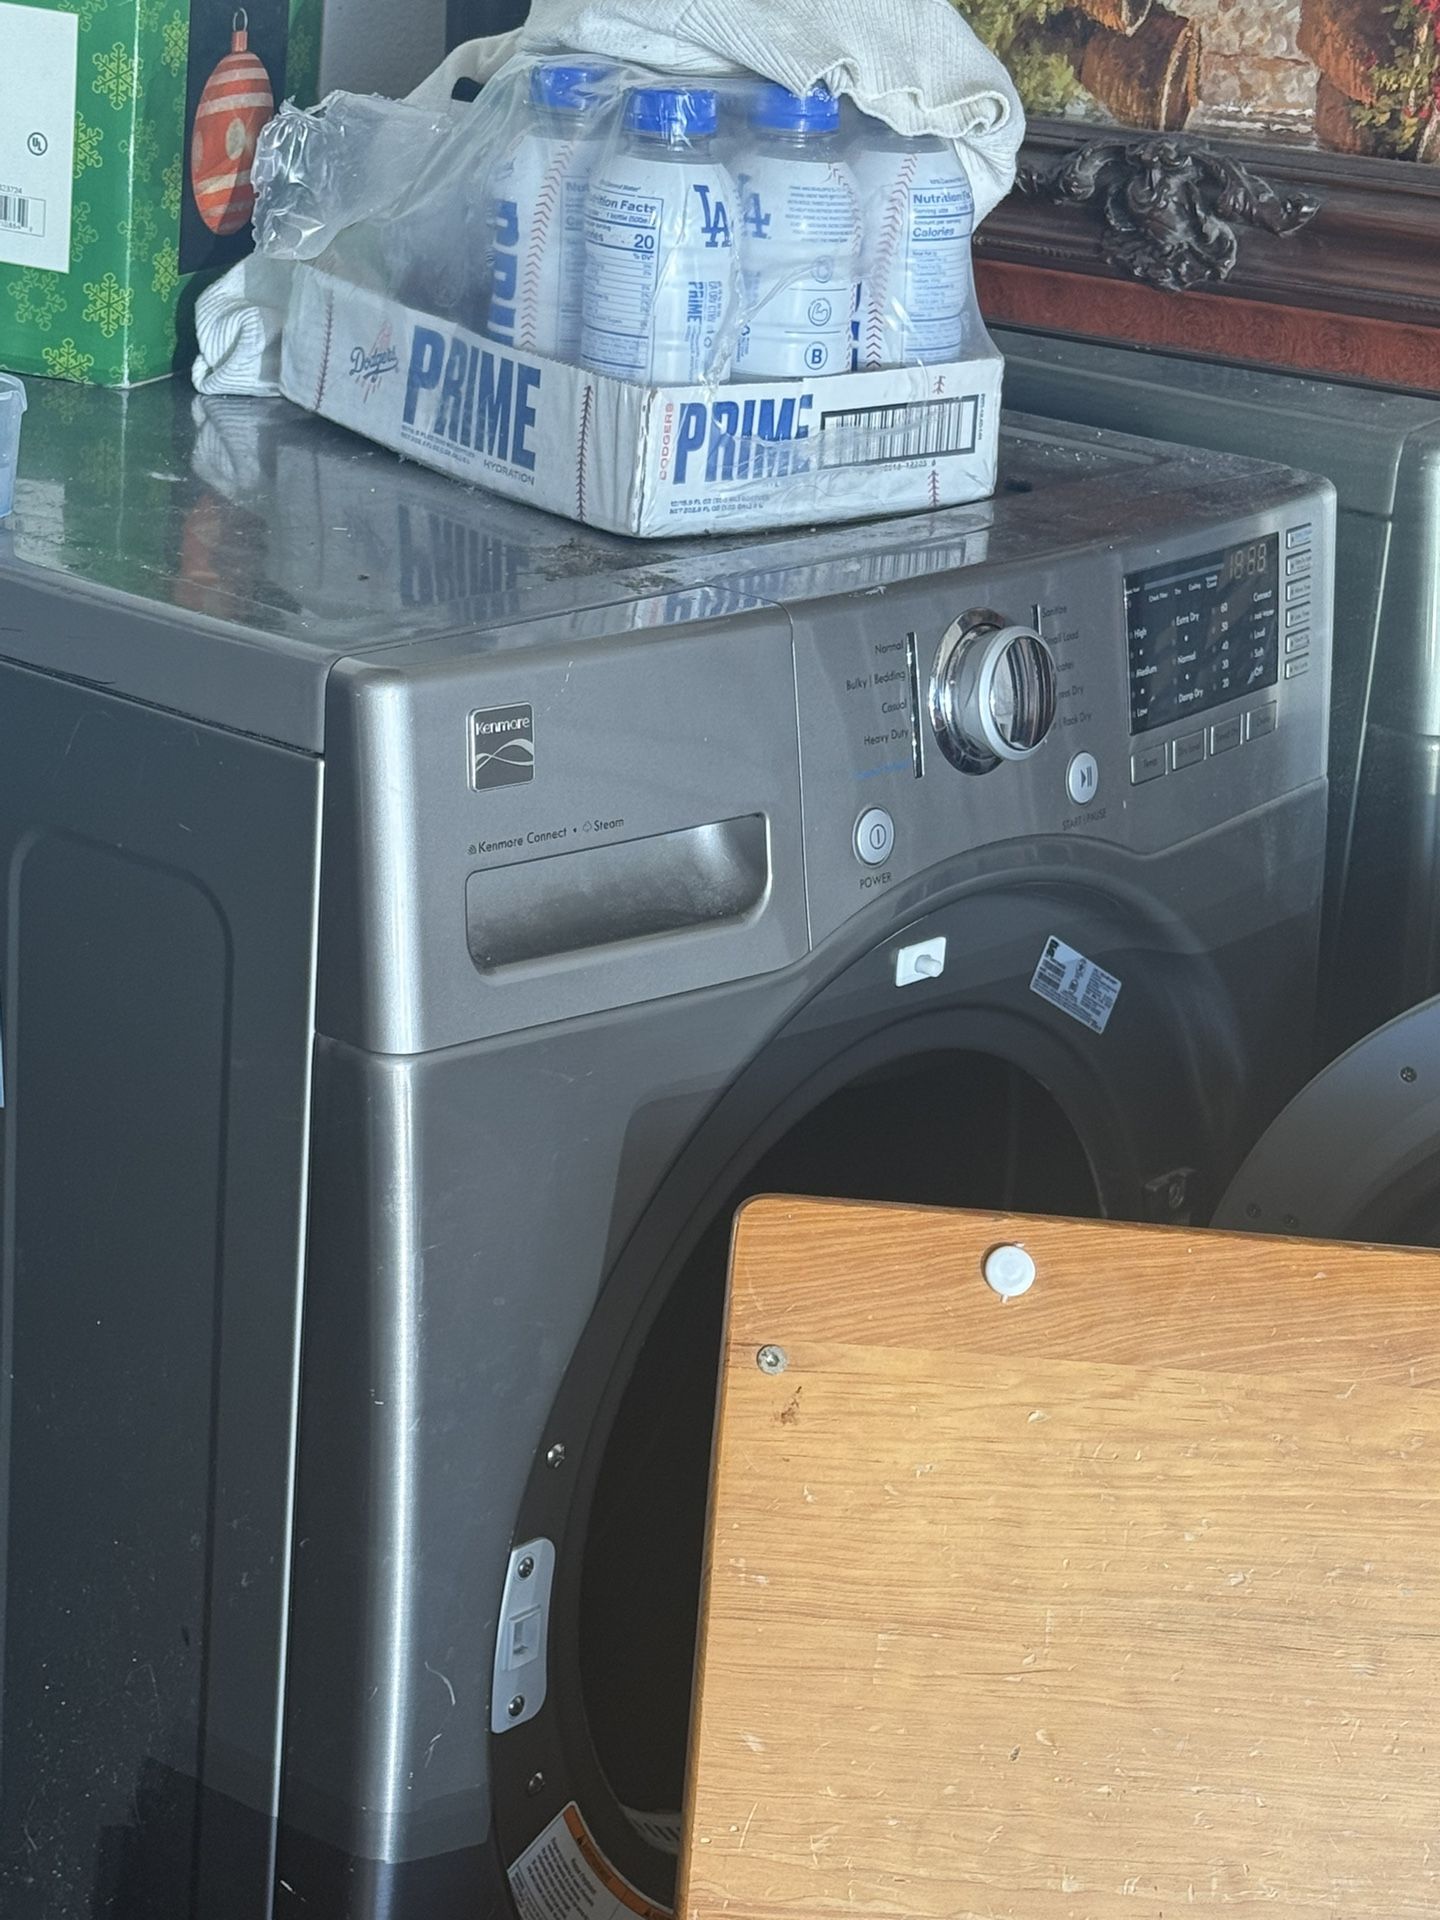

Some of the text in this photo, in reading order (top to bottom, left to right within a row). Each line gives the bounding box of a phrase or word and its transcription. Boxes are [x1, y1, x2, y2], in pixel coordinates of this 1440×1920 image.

[633, 233, 655, 250] 20
[912, 226, 955, 239] Calories
[687, 280, 704, 324] PRIME
[402, 325, 541, 471] PRIME
[483, 459, 536, 486] HYDRATION
[875, 639, 904, 654] Normal
[846, 678, 868, 692] Bulky
[874, 670, 906, 684] Bedding
[1071, 685, 1085, 697] Dry
[882, 700, 907, 714] Casual
[475, 716, 531, 736] Kenmore
[864, 728, 909, 746] Heavy Duty
[478, 817, 625, 854] Kenmore Connect Steam
[859, 871, 892, 890] POWER
